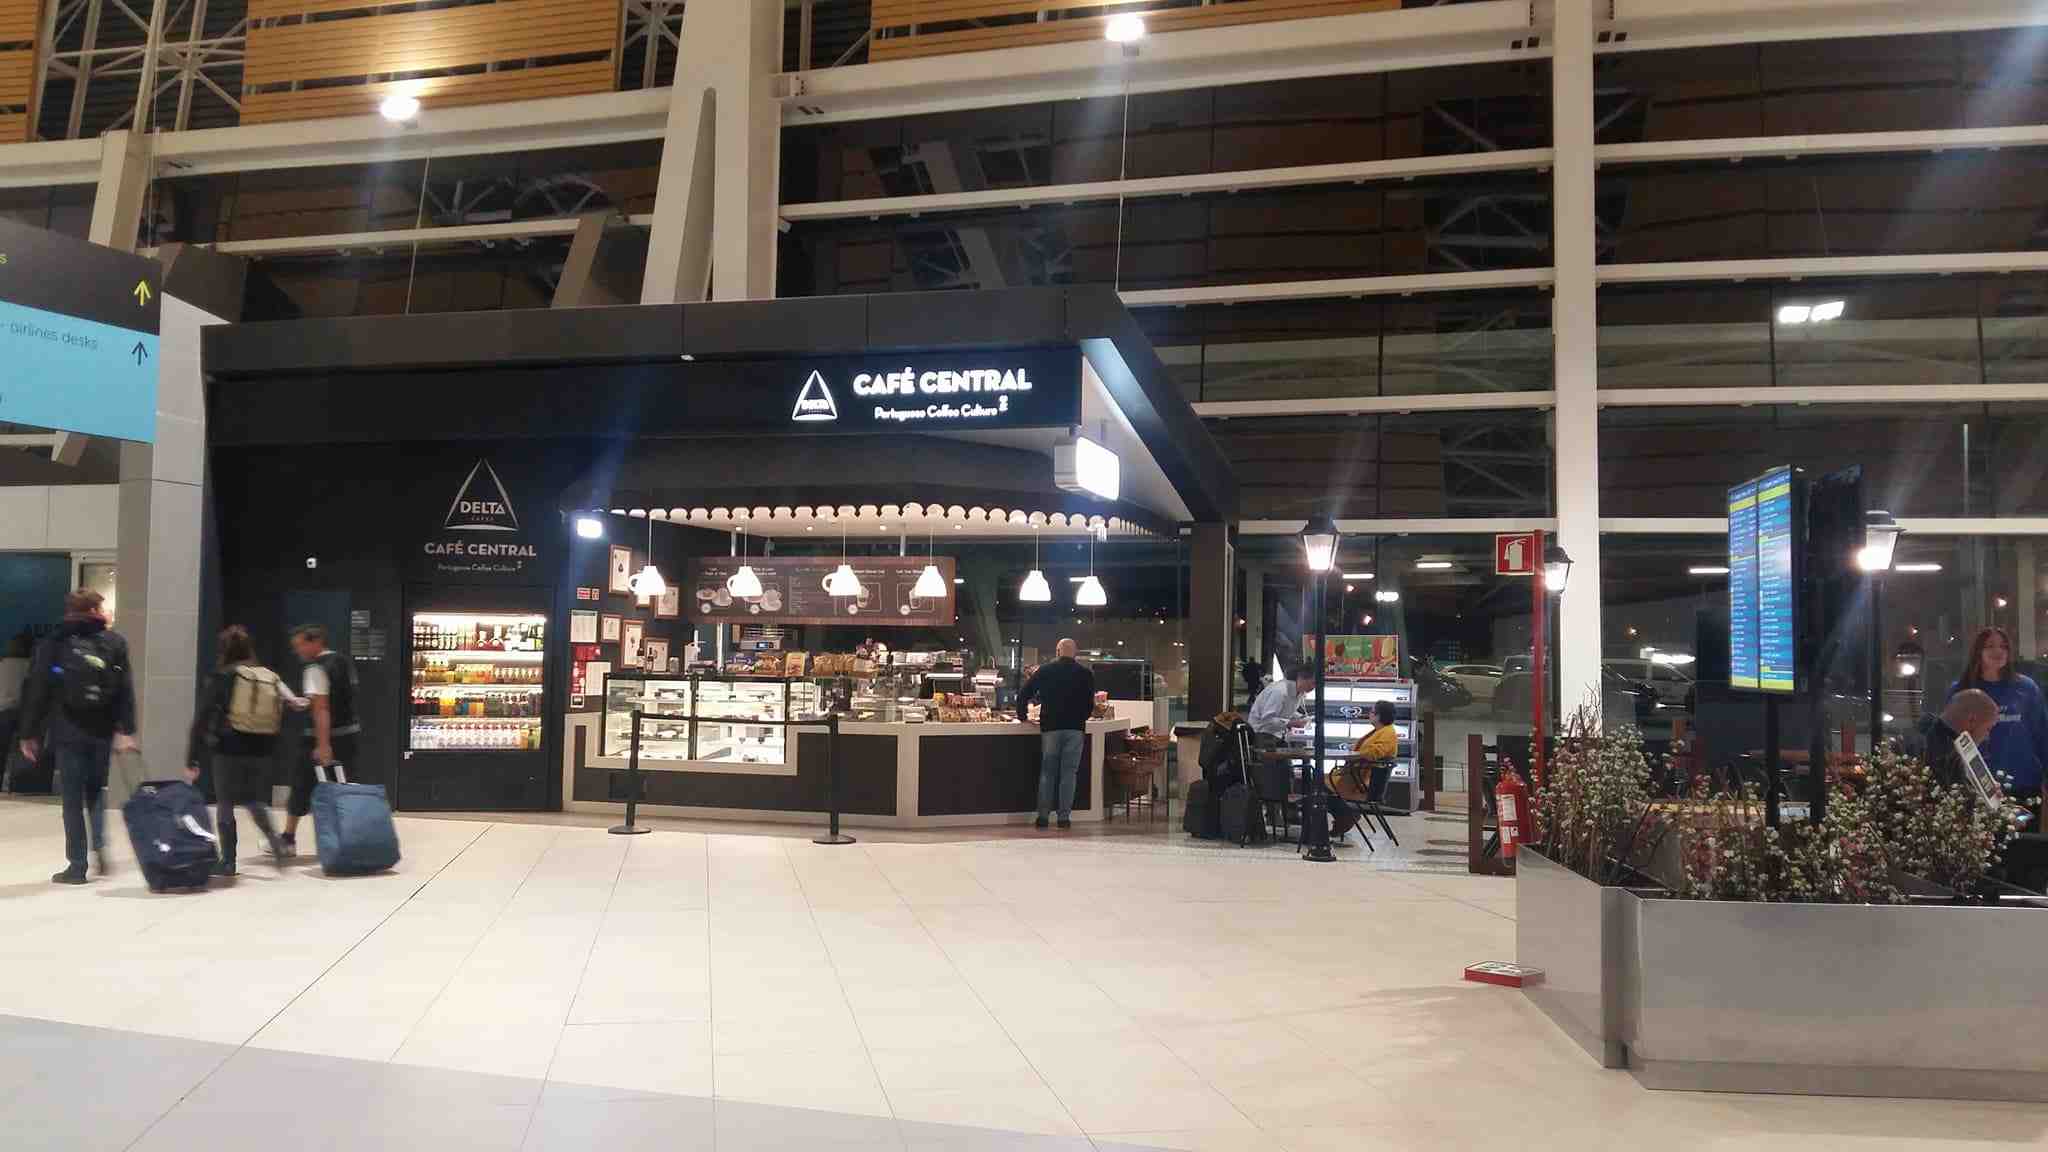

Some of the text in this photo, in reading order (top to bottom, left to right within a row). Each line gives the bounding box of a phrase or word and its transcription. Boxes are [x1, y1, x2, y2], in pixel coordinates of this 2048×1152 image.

[9, 320, 98, 350] airlines desks
[853, 367, 1033, 396] CAFÉ CENTRAL
[460, 501, 506, 514] DELTA
[424, 540, 537, 556] CAFÉ CENTRAL
